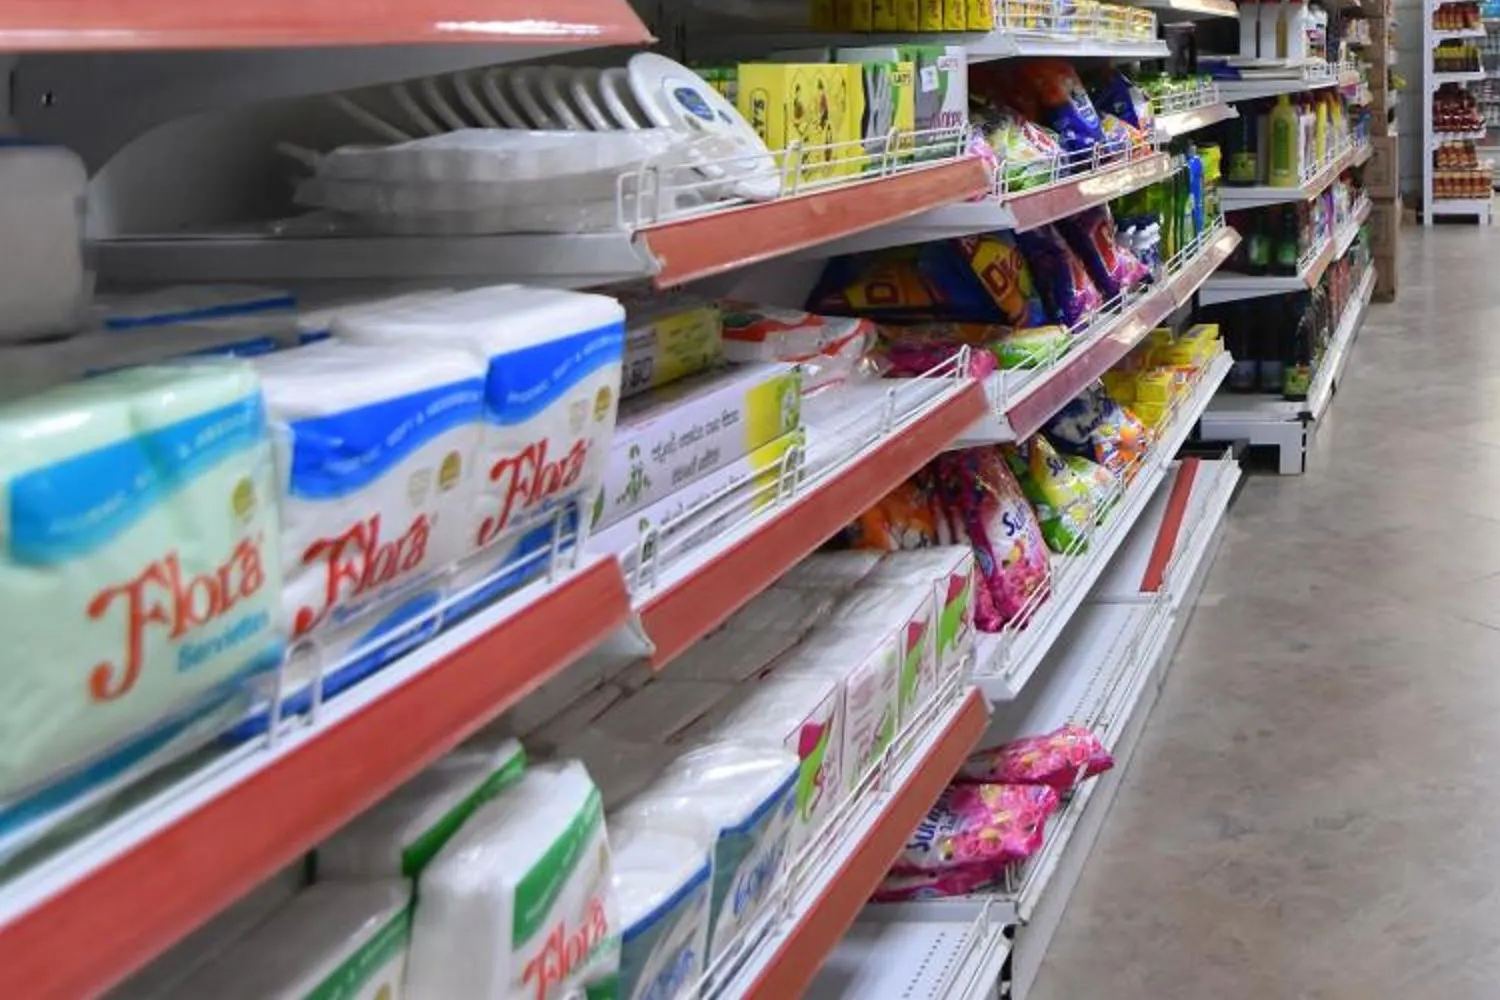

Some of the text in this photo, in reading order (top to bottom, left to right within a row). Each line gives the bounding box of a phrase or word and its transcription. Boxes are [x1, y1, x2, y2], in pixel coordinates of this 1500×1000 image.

[478, 437, 588, 546] Flora
[84, 536, 265, 703] Flora
[291, 511, 432, 641] Flora
[521, 895, 608, 1000] Flora
